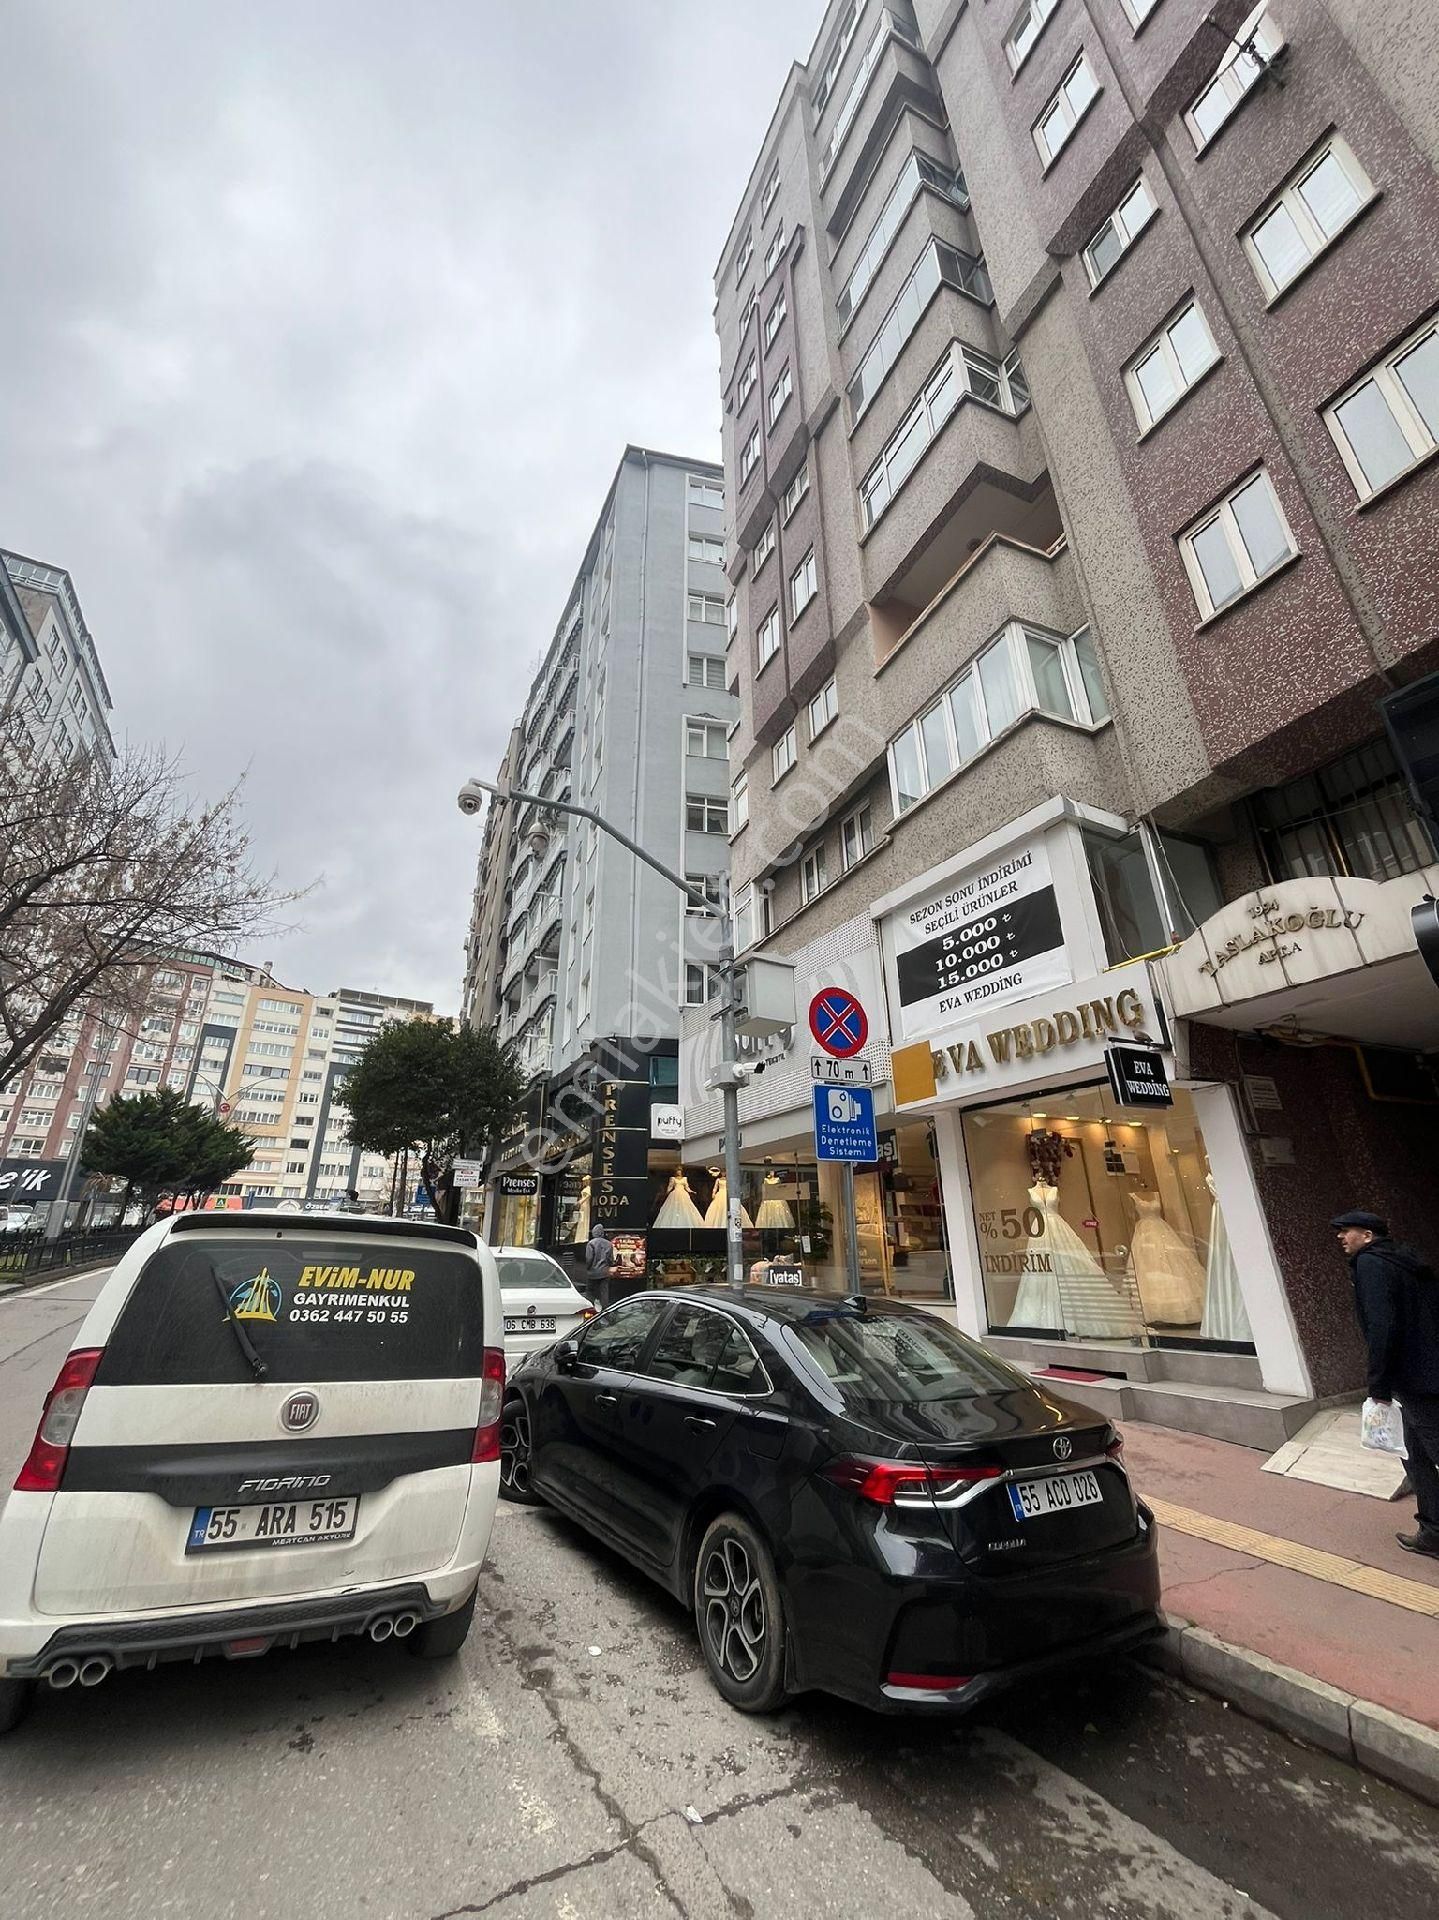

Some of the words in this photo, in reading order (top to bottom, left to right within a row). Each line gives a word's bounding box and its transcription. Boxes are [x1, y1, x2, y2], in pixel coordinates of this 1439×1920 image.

[910, 900, 943, 925] SEZON
[944, 883, 974, 907] SONU
[978, 850, 1033, 892] İNDİRİMİ
[924, 907, 959, 934] SEÇİLİ
[961, 880, 1018, 916] ÜRÜNLER
[942, 917, 997, 951] 5.000
[935, 935, 1000, 971] 10.000
[937, 953, 1003, 989] 15.000
[939, 996, 962, 1013] EVA
[963, 972, 1023, 1003] WEDDİNG
[931, 1040, 984, 1080] EVA
[986, 988, 1144, 1064] WEDDING
[826, 1060, 840, 1077] 70
[845, 1069, 854, 1079] m
[1133, 1061, 1154, 1075] EVA
[822, 1125, 870, 1136] Elektronik
[821, 1136, 872, 1147] Denetleme
[829, 1147, 866, 1156] Sistemi
[979, 1211, 996, 1222] NET
[289, 1309, 329, 1322] 0362
[334, 1310, 363, 1322] 447
[367, 1311, 386, 1323] 50
[390, 1311, 409, 1323] 55
[290, 1403, 312, 1420] FIAT
[237, 1475, 332, 1493] FIORINO
[1020, 1484, 1041, 1513] 55
[194, 1529, 205, 1538] TR
[207, 1509, 241, 1540] 55
[255, 1505, 296, 1537] ARA
[309, 1501, 348, 1531] 515
[272, 1537, 315, 1546] MERTCAN
